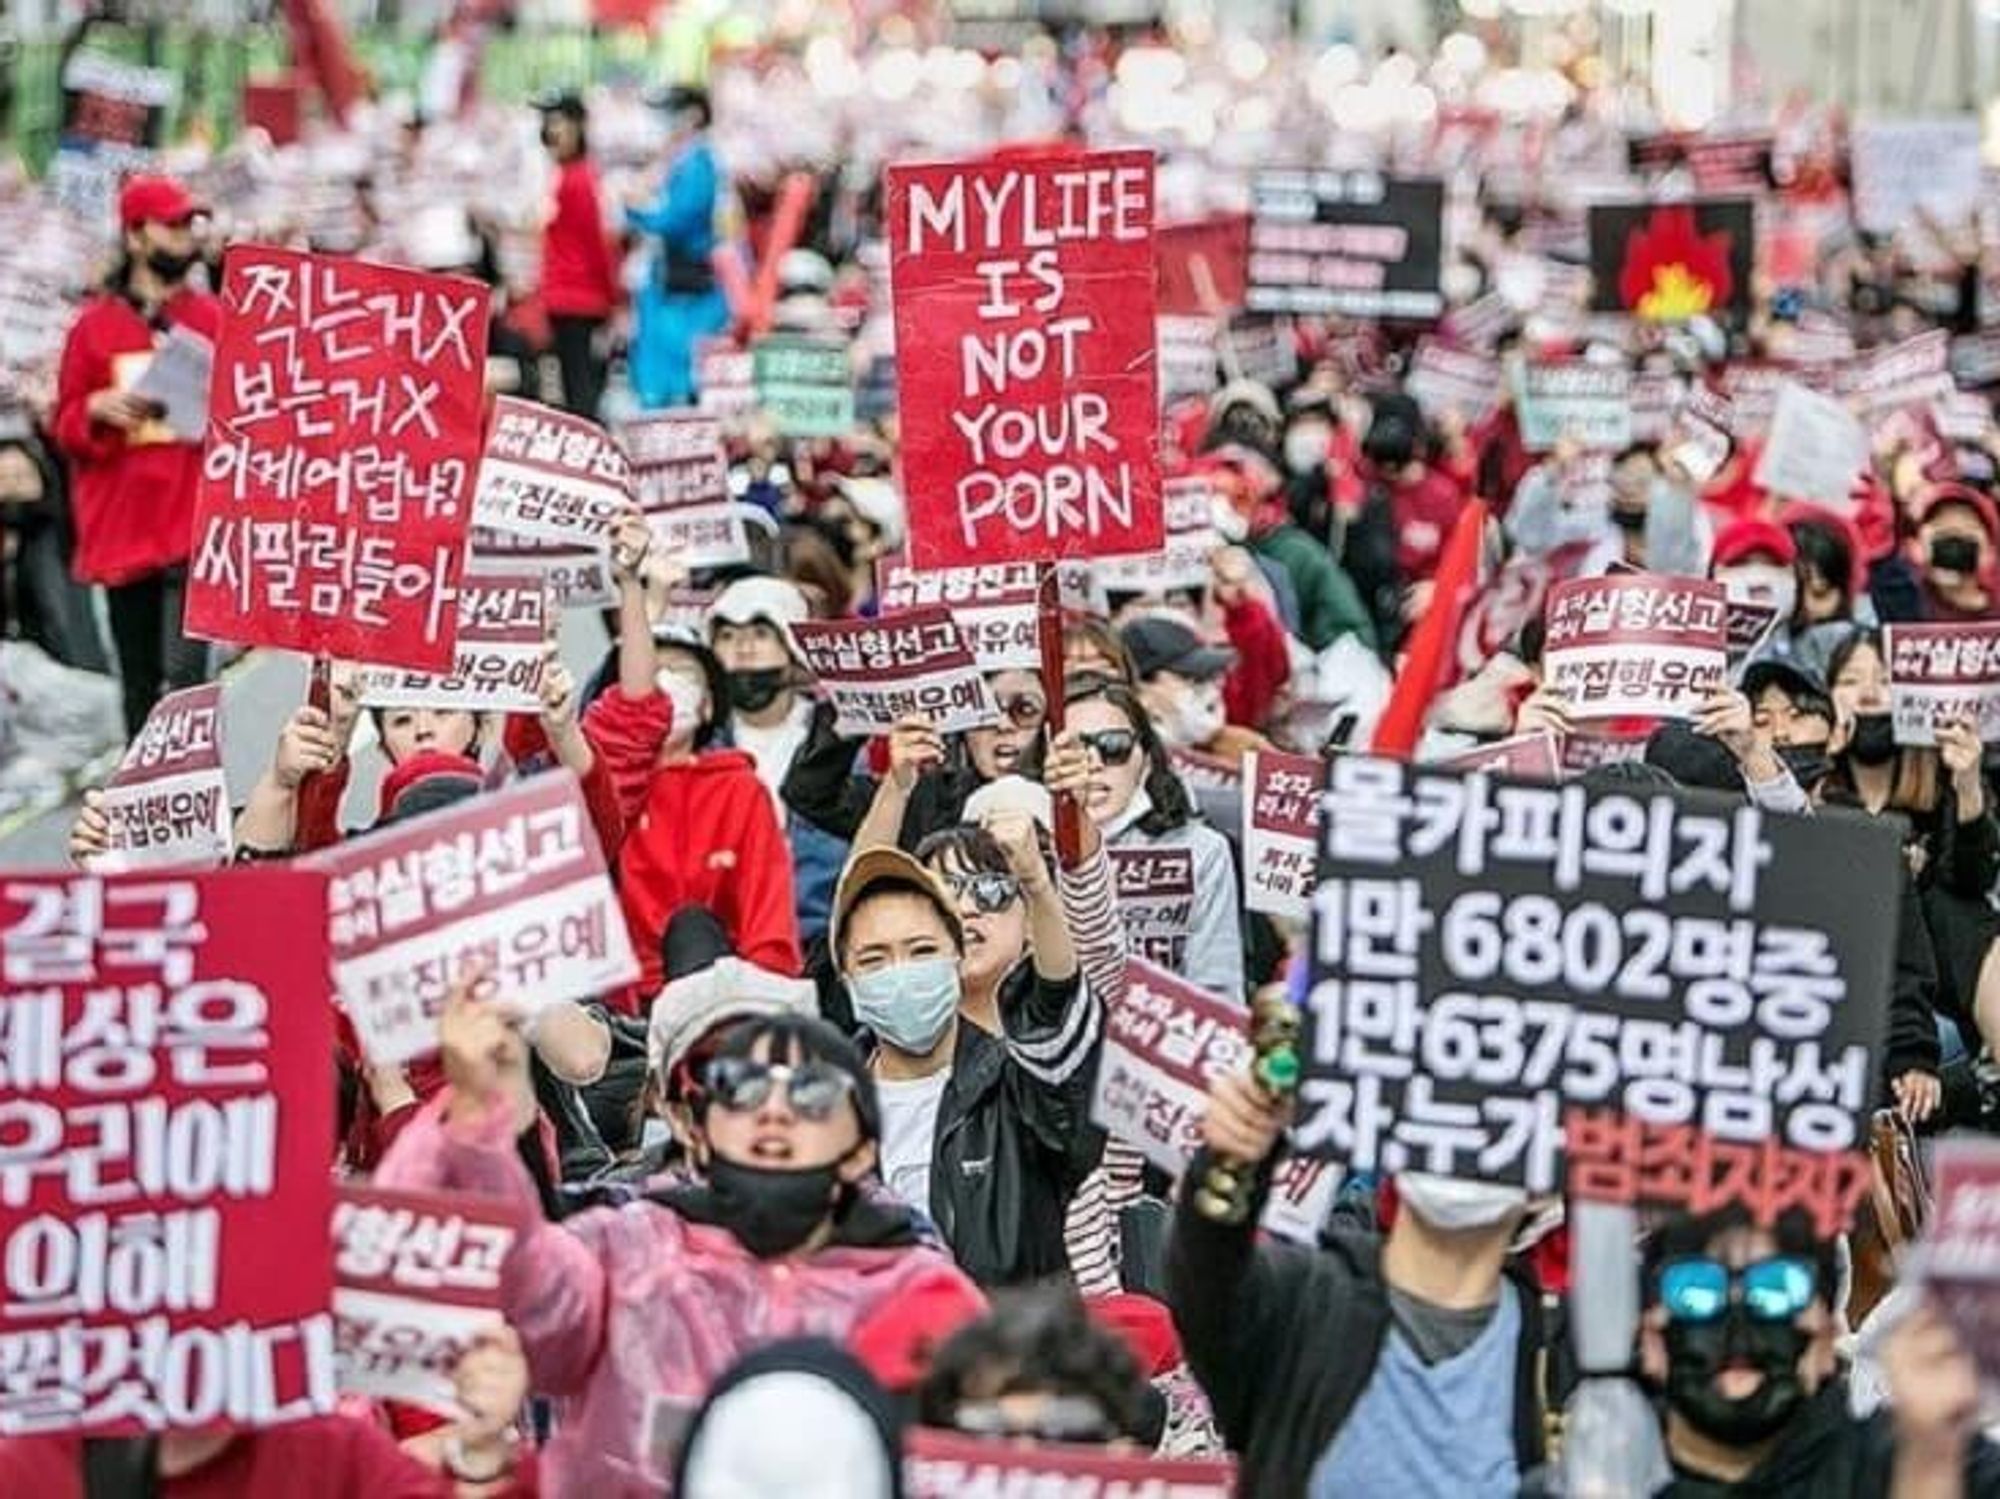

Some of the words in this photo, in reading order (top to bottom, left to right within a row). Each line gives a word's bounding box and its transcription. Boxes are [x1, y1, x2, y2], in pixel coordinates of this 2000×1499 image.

[975, 250, 1064, 318] IS
[961, 316, 1092, 397] NOT
[952, 393, 1119, 465] YOUR
[956, 463, 1133, 548] PORN
[1583, 587, 1724, 634] 실형선고
[377, 803, 584, 932] 실형선고
[1320, 756, 1773, 910] 몰카피의자
[2, 878, 207, 986] 결국
[1311, 878, 1433, 978] 1만
[0, 1093, 278, 1204] 우리에
[4, 1207, 221, 1316] 의해
